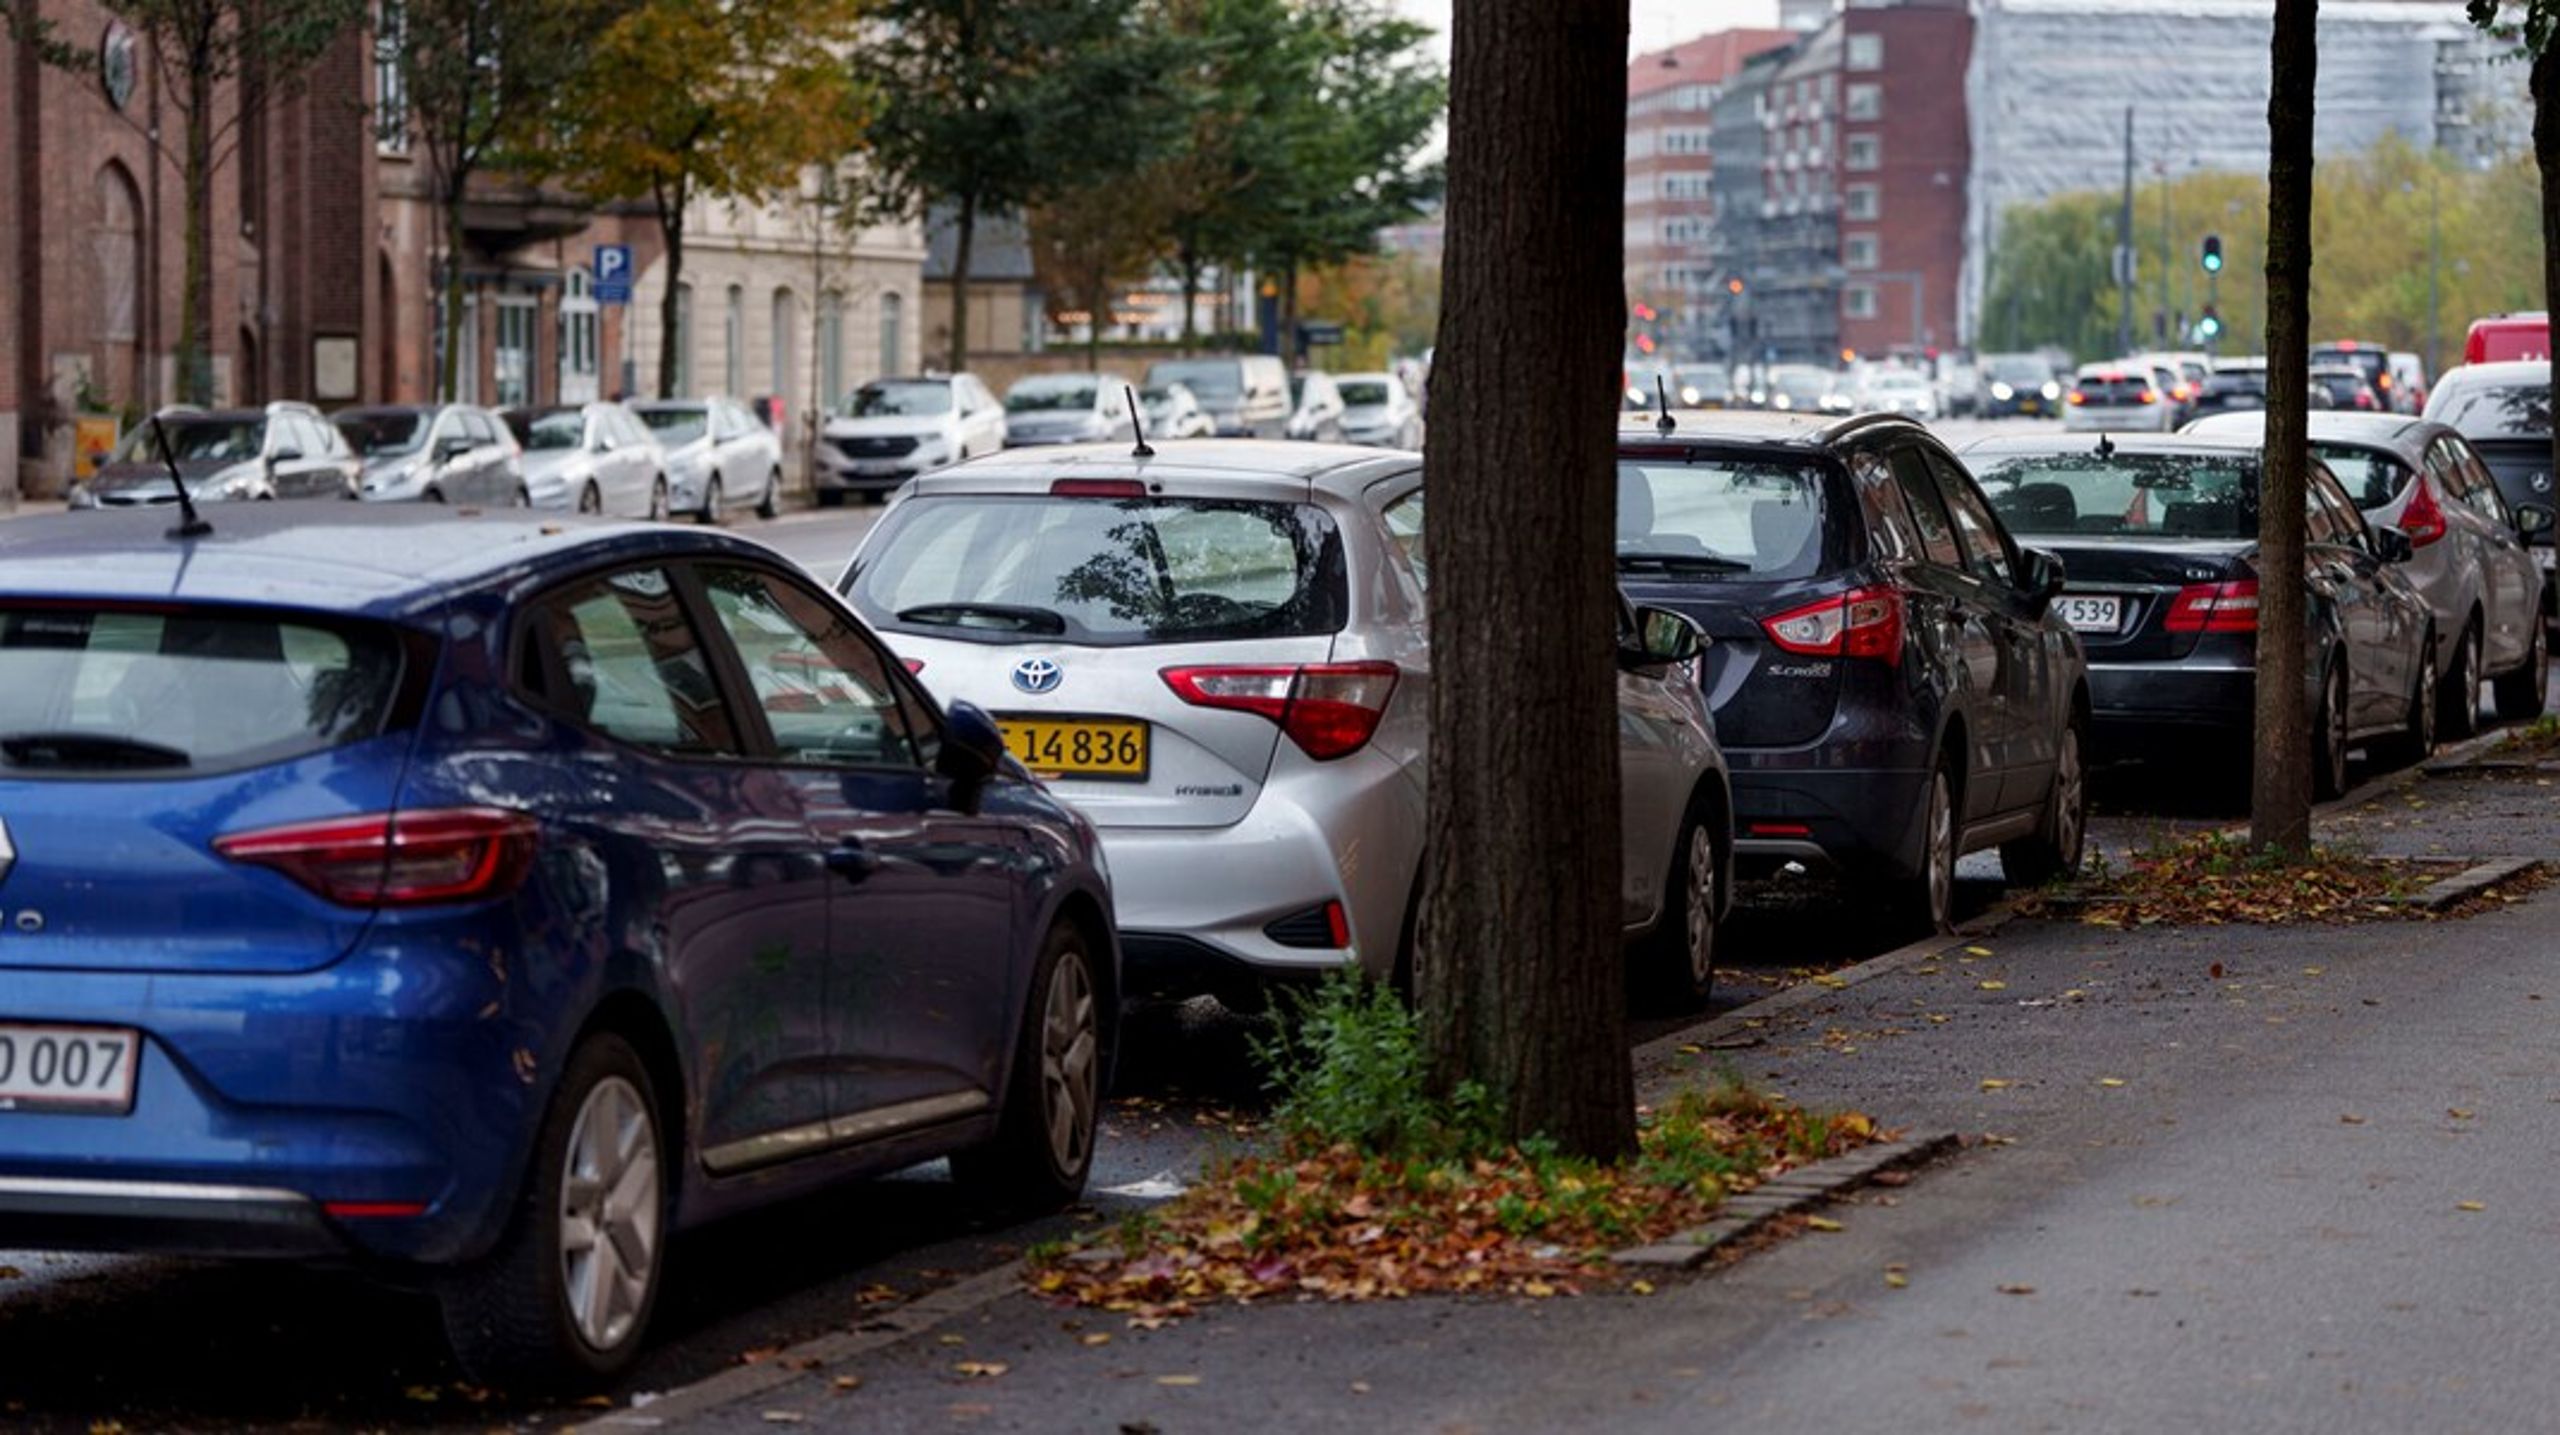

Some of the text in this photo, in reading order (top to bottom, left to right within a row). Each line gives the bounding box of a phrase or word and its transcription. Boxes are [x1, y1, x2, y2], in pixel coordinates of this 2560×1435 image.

[601, 249, 623, 279] P
[2073, 600, 2116, 622] 539
[1023, 729, 1062, 763] 14
[1072, 729, 1138, 765] 836
[29, 1036, 125, 1089] 007
